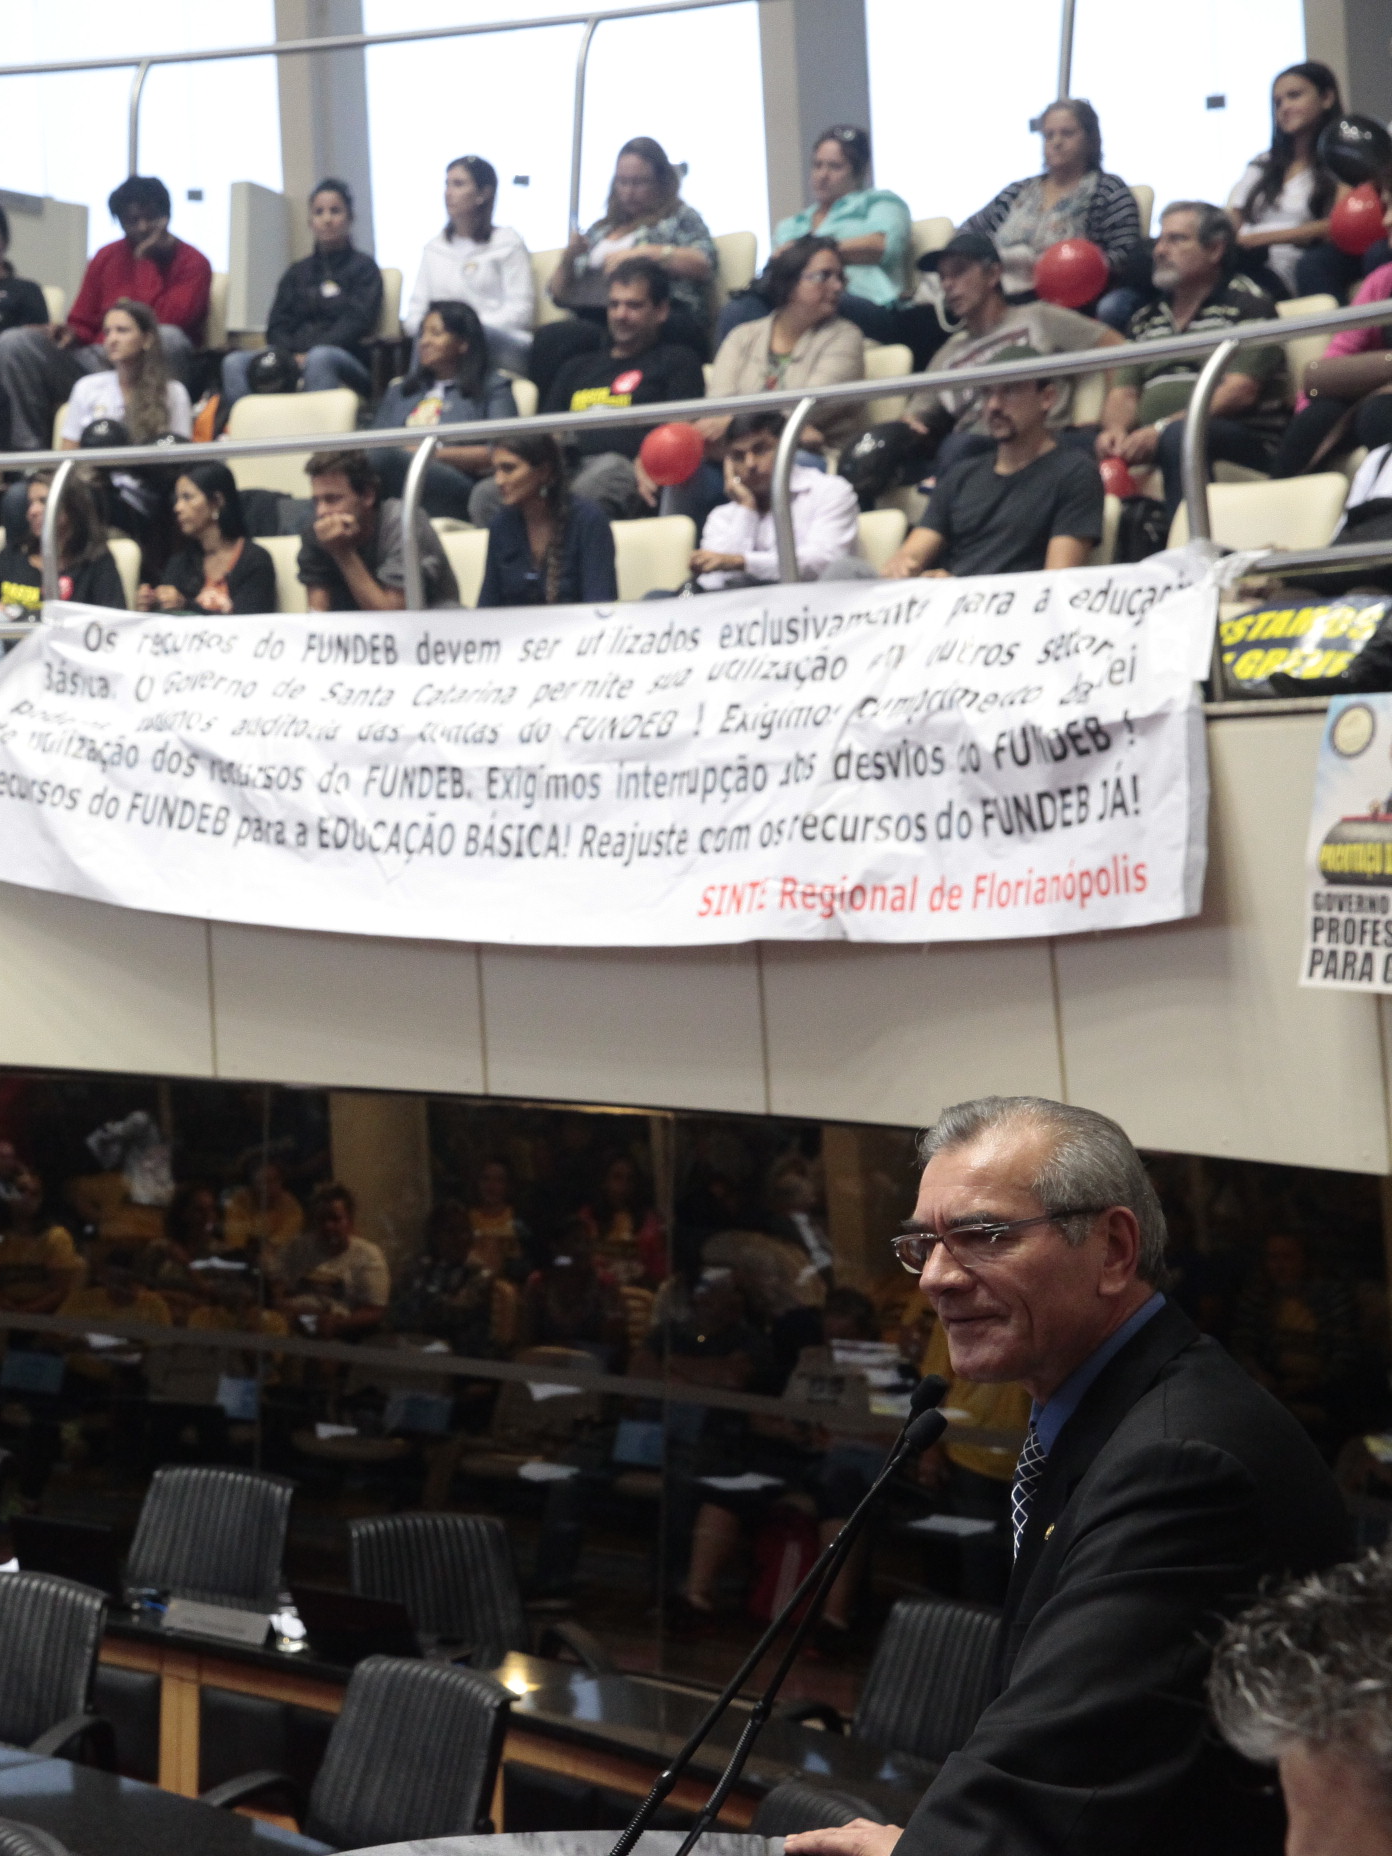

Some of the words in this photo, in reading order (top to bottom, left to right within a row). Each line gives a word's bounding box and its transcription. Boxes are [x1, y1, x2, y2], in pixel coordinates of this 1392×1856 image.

[84, 622, 118, 652] Os
[254, 630, 286, 661] do
[301, 632, 400, 666] FUNDEB
[416, 632, 502, 666] devem
[517, 636, 562, 662] ser
[944, 588, 1016, 627] para
[1033, 587, 1051, 615] a
[135, 675, 155, 702] O
[163, 670, 258, 699] Governo
[272, 676, 306, 700] de
[320, 681, 396, 708] Santa
[412, 679, 518, 707] Catarina
[529, 671, 633, 708] permite
[519, 716, 552, 745] do
[565, 708, 679, 743] FUNDEB
[1096, 644, 1138, 688] ei
[151, 740, 198, 777] dos
[318, 761, 351, 795] do
[363, 764, 472, 799] FUNDEB.
[486, 764, 601, 809] Exigimos
[615, 754, 769, 805] interrupção
[833, 738, 945, 781] desvios
[993, 716, 1113, 770] FUNDEB
[88, 786, 120, 820] do
[127, 791, 230, 837] FUNDEB
[234, 813, 285, 848] para
[295, 821, 308, 846] a
[317, 811, 456, 865] EDUCAÇÃO
[464, 810, 571, 858] BÁSICA!
[579, 820, 689, 868] Reajuste
[698, 822, 750, 854] com
[787, 811, 927, 843] recursos
[935, 799, 973, 840] do
[981, 784, 1090, 837] FUNDEB
[1098, 760, 1141, 821] JÁ!
[779, 874, 919, 919] Regional
[928, 875, 963, 912] de
[971, 853, 1149, 911] Florianópolis
[1313, 891, 1390, 914] GOVERNO
[1308, 949, 1375, 983] PARA
